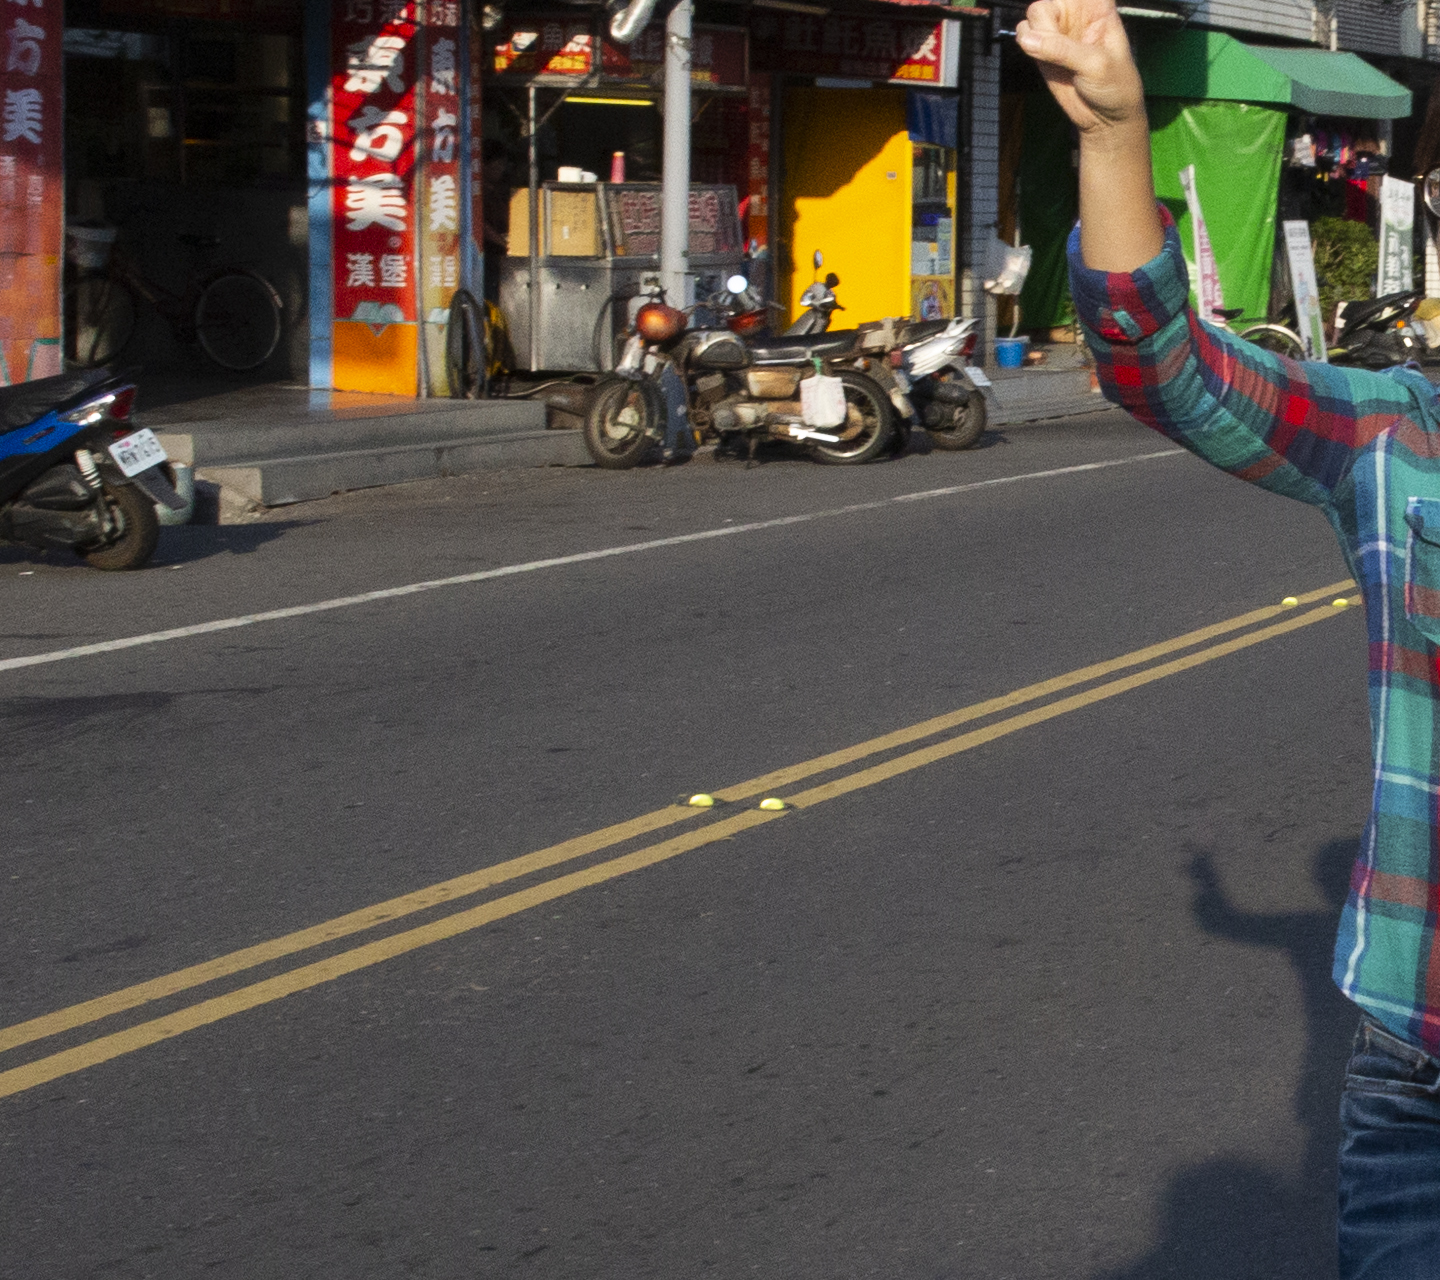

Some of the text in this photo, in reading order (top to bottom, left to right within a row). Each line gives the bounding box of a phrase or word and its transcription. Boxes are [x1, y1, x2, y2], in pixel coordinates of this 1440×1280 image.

[345, 35, 407, 232] 東方美
[347, 252, 409, 289] 漢堡
